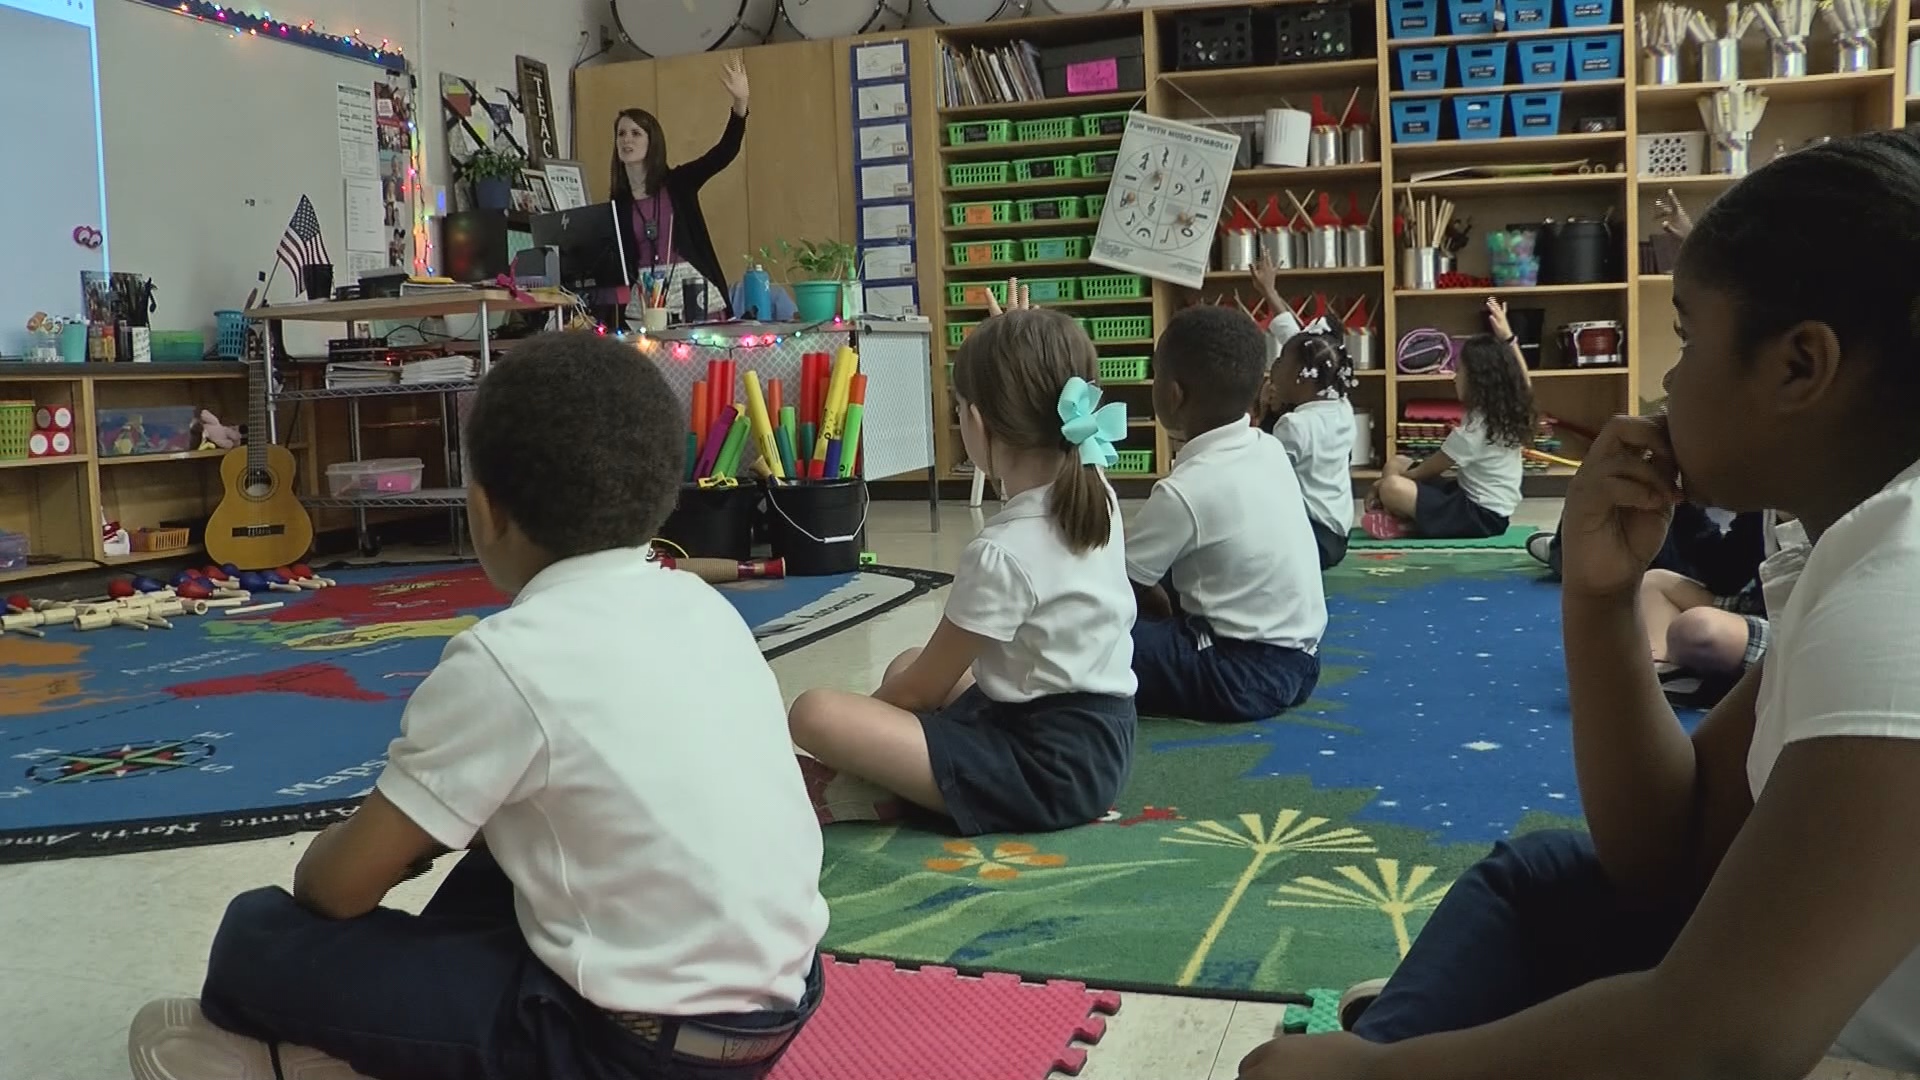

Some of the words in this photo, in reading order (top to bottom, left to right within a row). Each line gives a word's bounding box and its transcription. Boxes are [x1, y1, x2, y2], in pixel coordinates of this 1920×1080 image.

[1129, 121, 1145, 131] FUN
[1146, 125, 1167, 136] WITH
[1168, 130, 1193, 142] MUSIC
[274, 759, 388, 797] Maps
[91, 821, 201, 842] North
